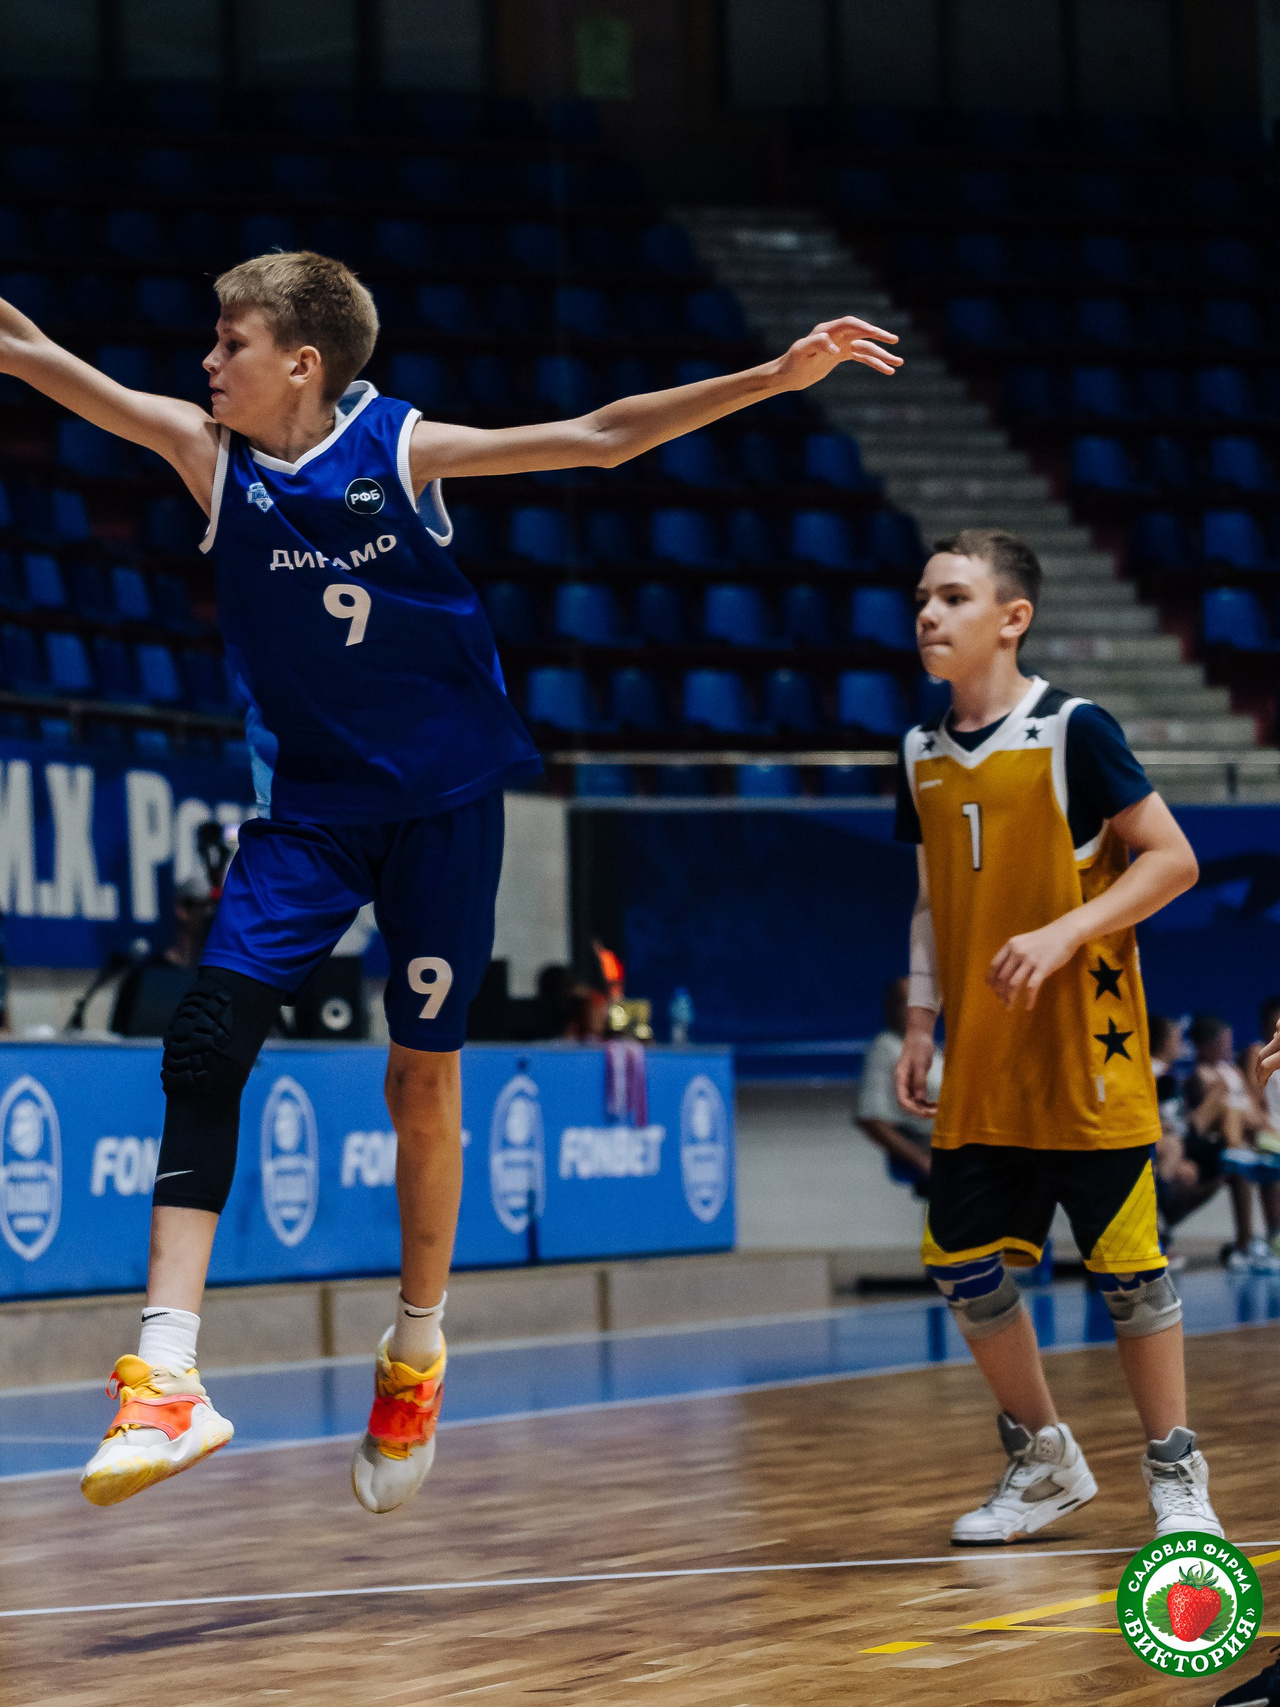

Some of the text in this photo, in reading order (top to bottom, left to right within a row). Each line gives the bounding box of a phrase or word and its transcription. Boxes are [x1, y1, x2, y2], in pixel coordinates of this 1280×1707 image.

[350, 489, 381, 504] РФБ
[323, 583, 371, 647] 9
[962, 802, 982, 871] 1
[407, 956, 454, 1019] 9
[558, 1124, 666, 1179] FONBET
